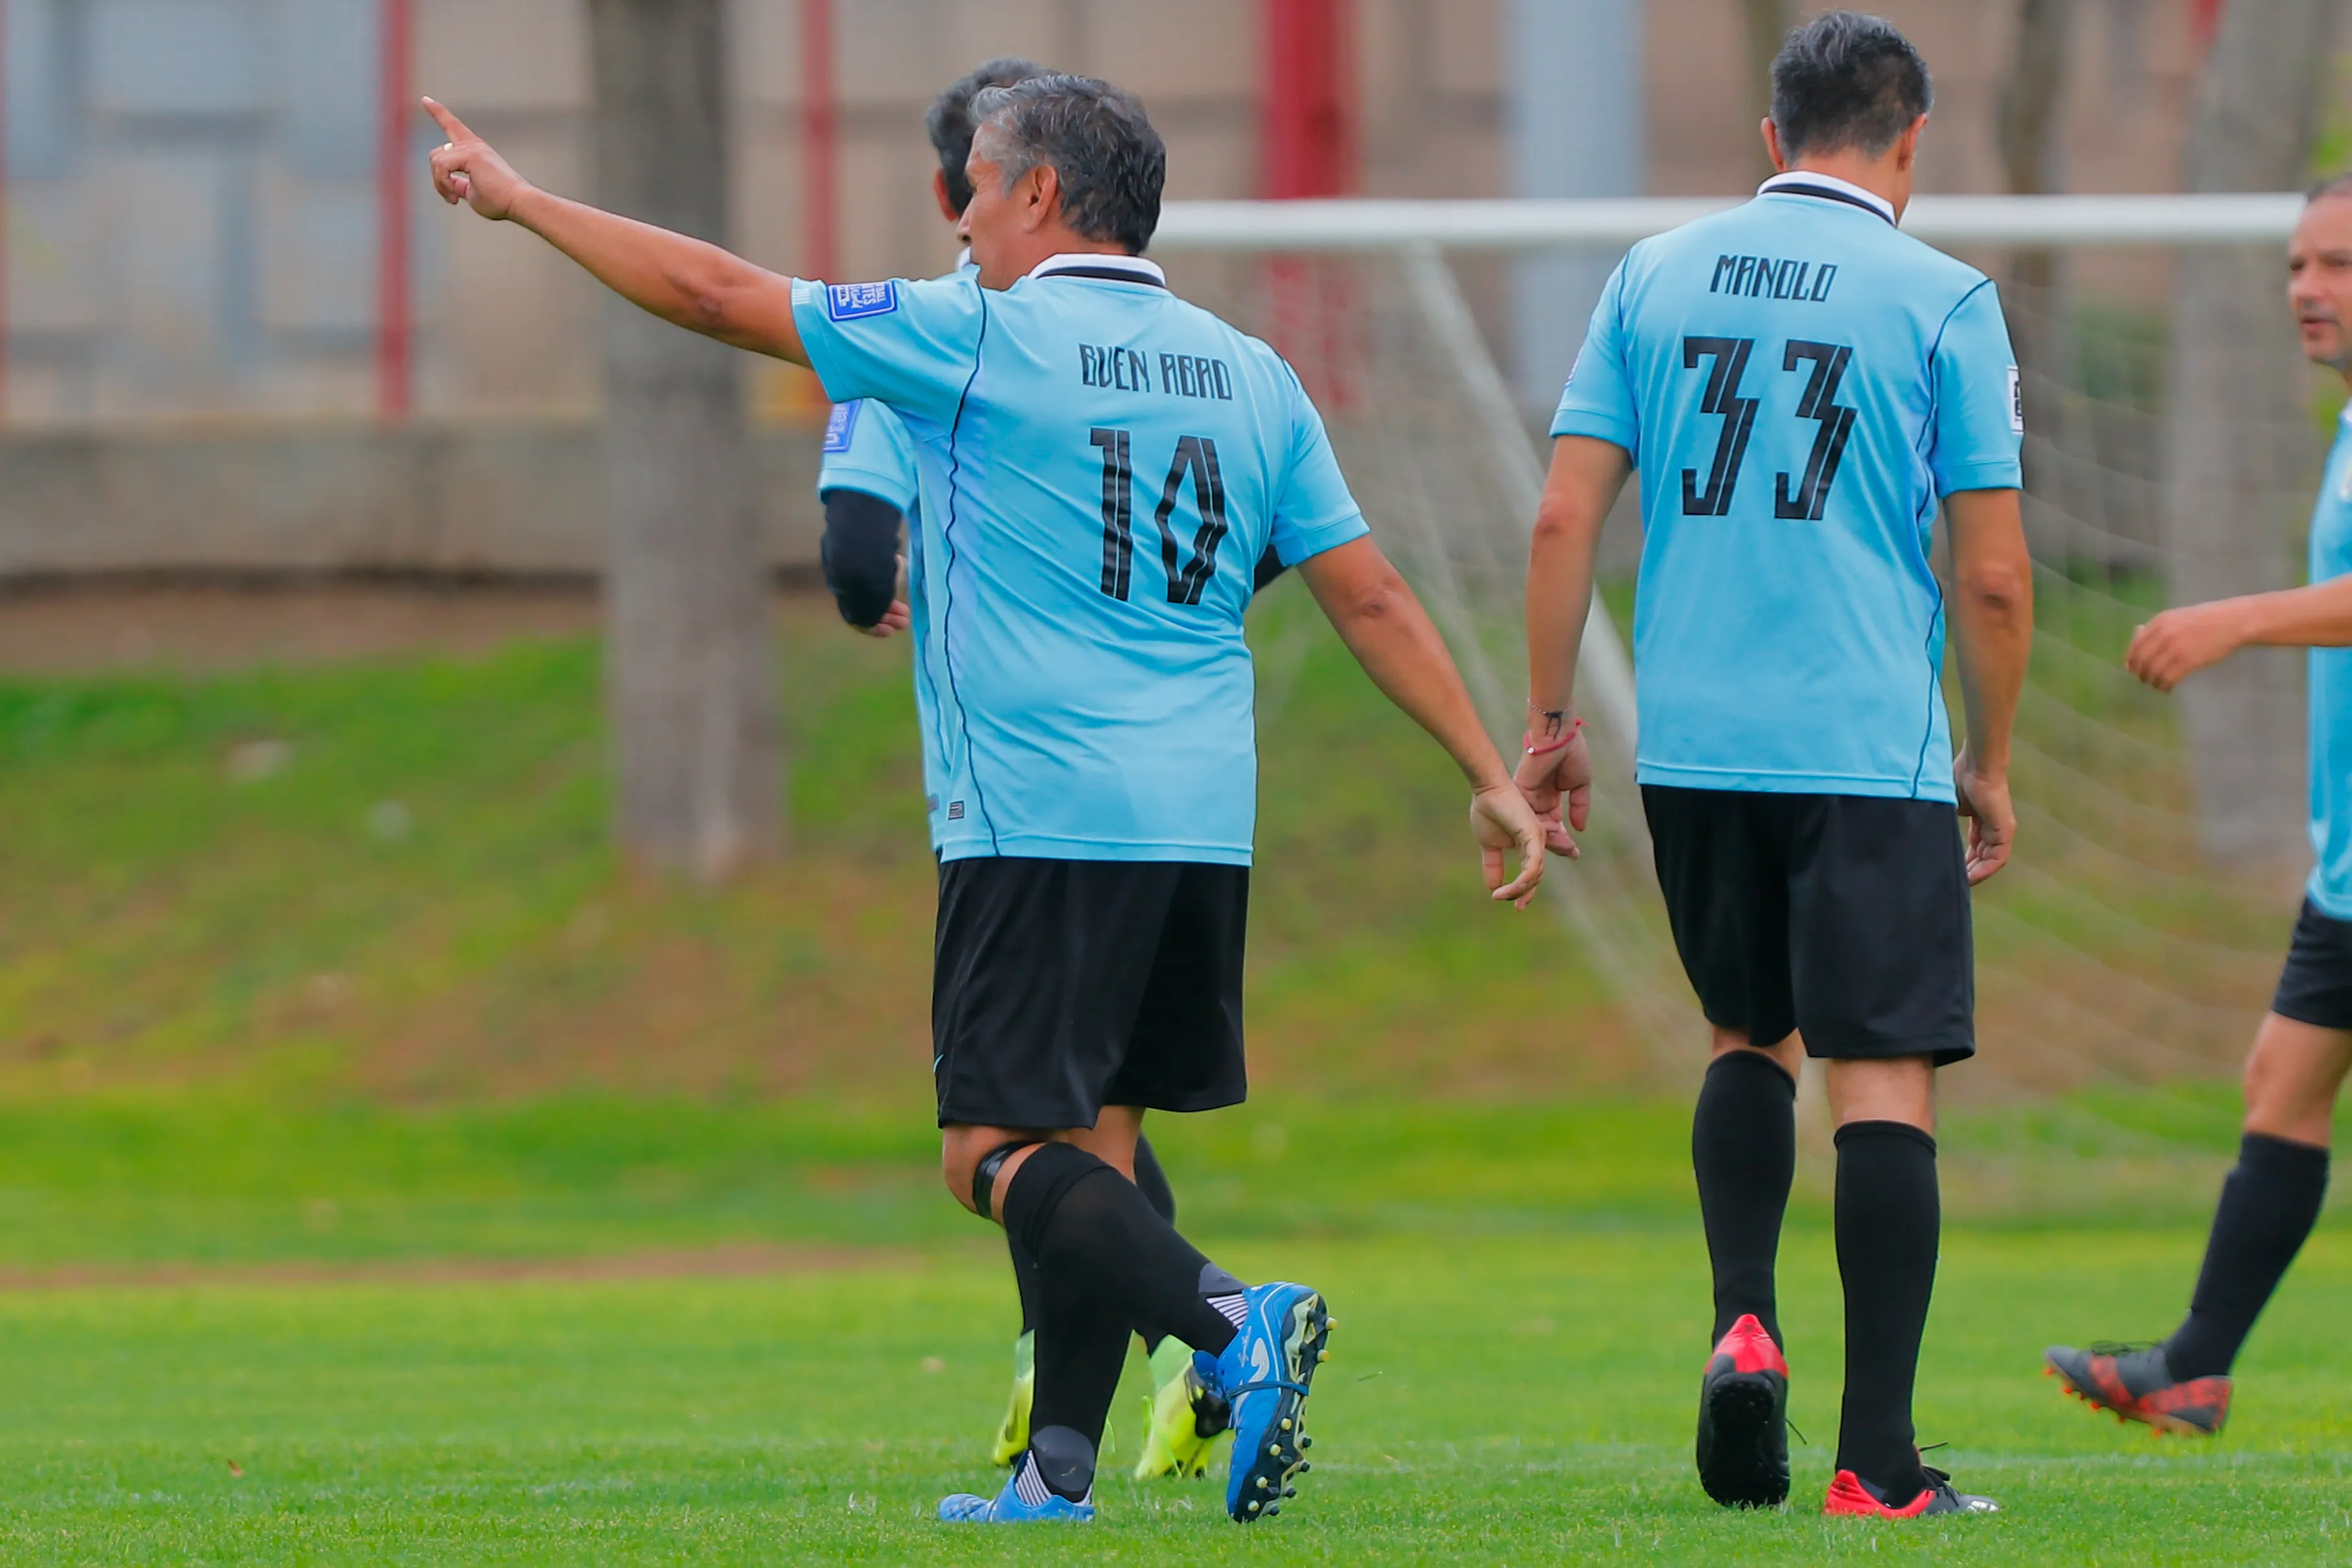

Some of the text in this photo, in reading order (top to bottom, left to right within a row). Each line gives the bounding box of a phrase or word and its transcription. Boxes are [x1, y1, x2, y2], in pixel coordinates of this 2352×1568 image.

[1709, 255, 1838, 302] MANOLO
[1079, 343, 1233, 400] BUEN ABAD
[1682, 335, 1858, 521] 33
[1090, 427, 1229, 606] 10
